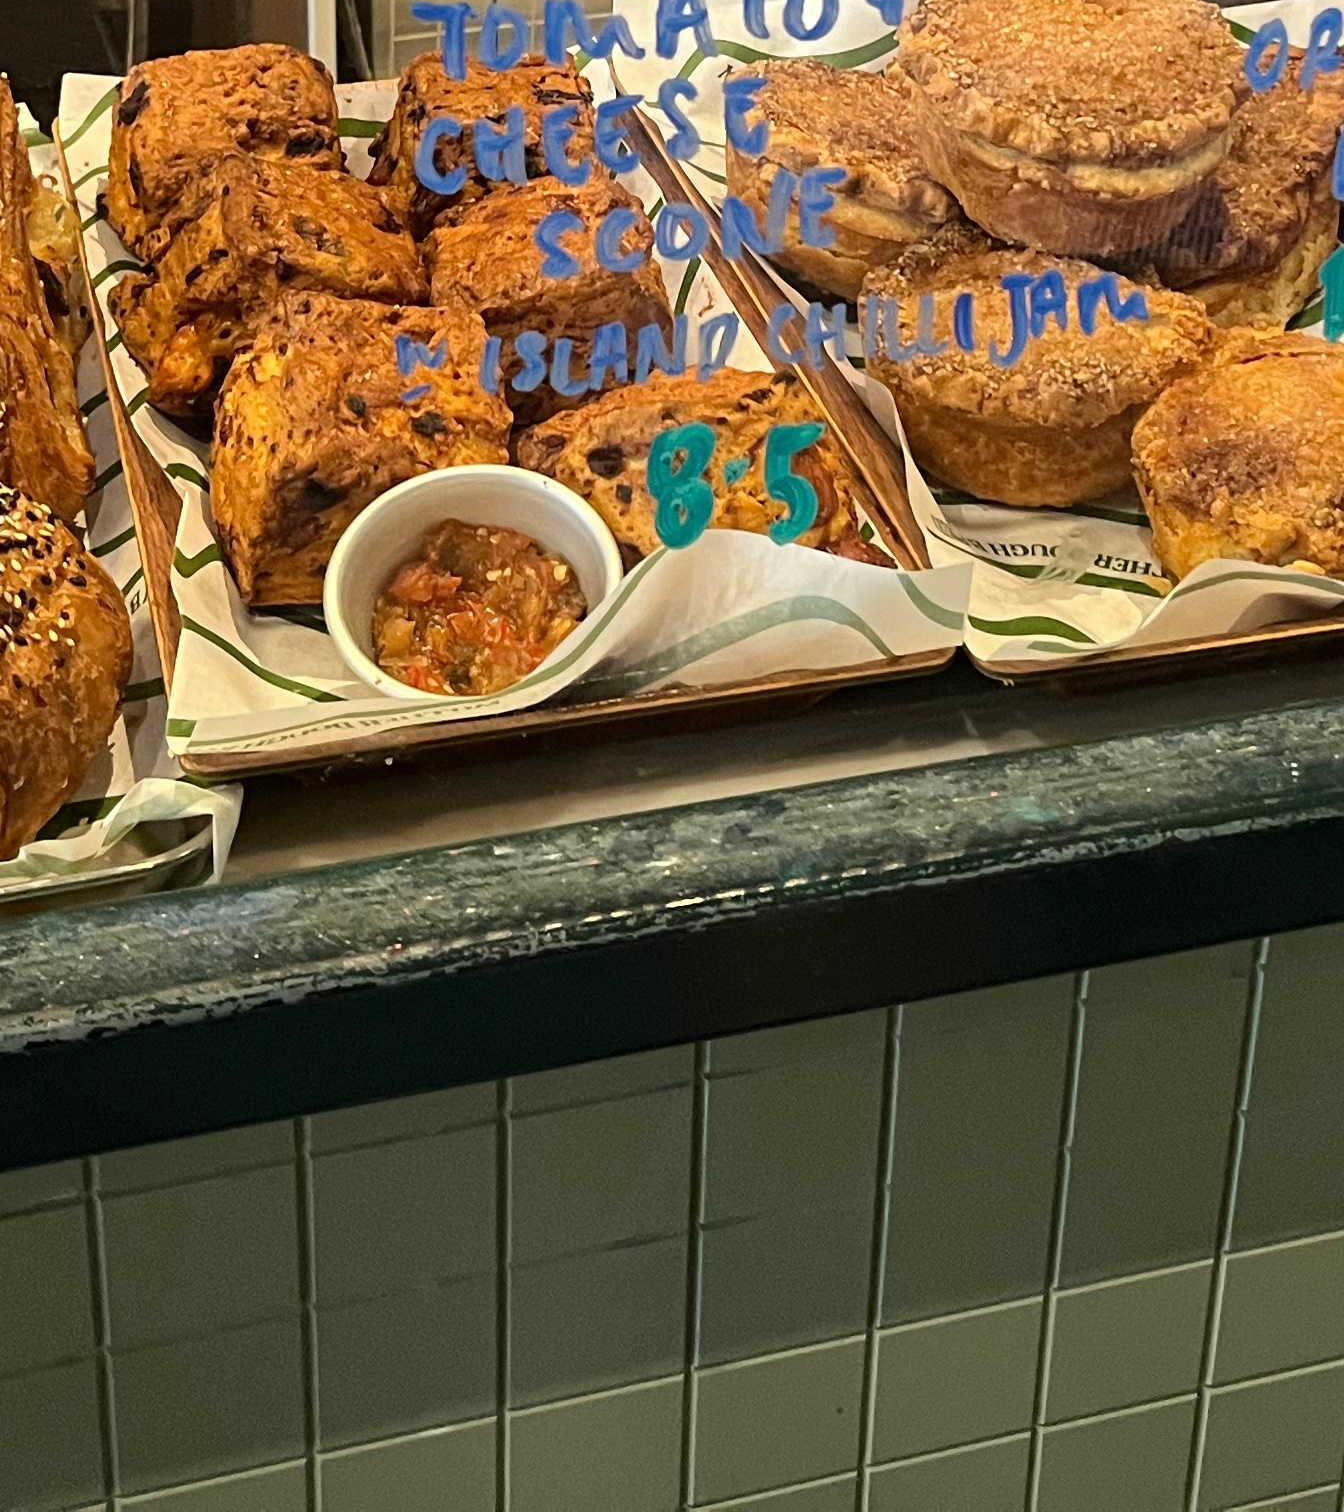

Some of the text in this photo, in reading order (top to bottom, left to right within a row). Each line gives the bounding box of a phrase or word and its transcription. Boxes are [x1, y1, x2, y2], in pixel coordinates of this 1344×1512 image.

[414, 78, 769, 196] CHEESE
[534, 166, 849, 279] SCONE
[479, 311, 740, 398] ISLAND
[767, 293, 975, 371] CHILLI
[988, 269, 1150, 369] JAM
